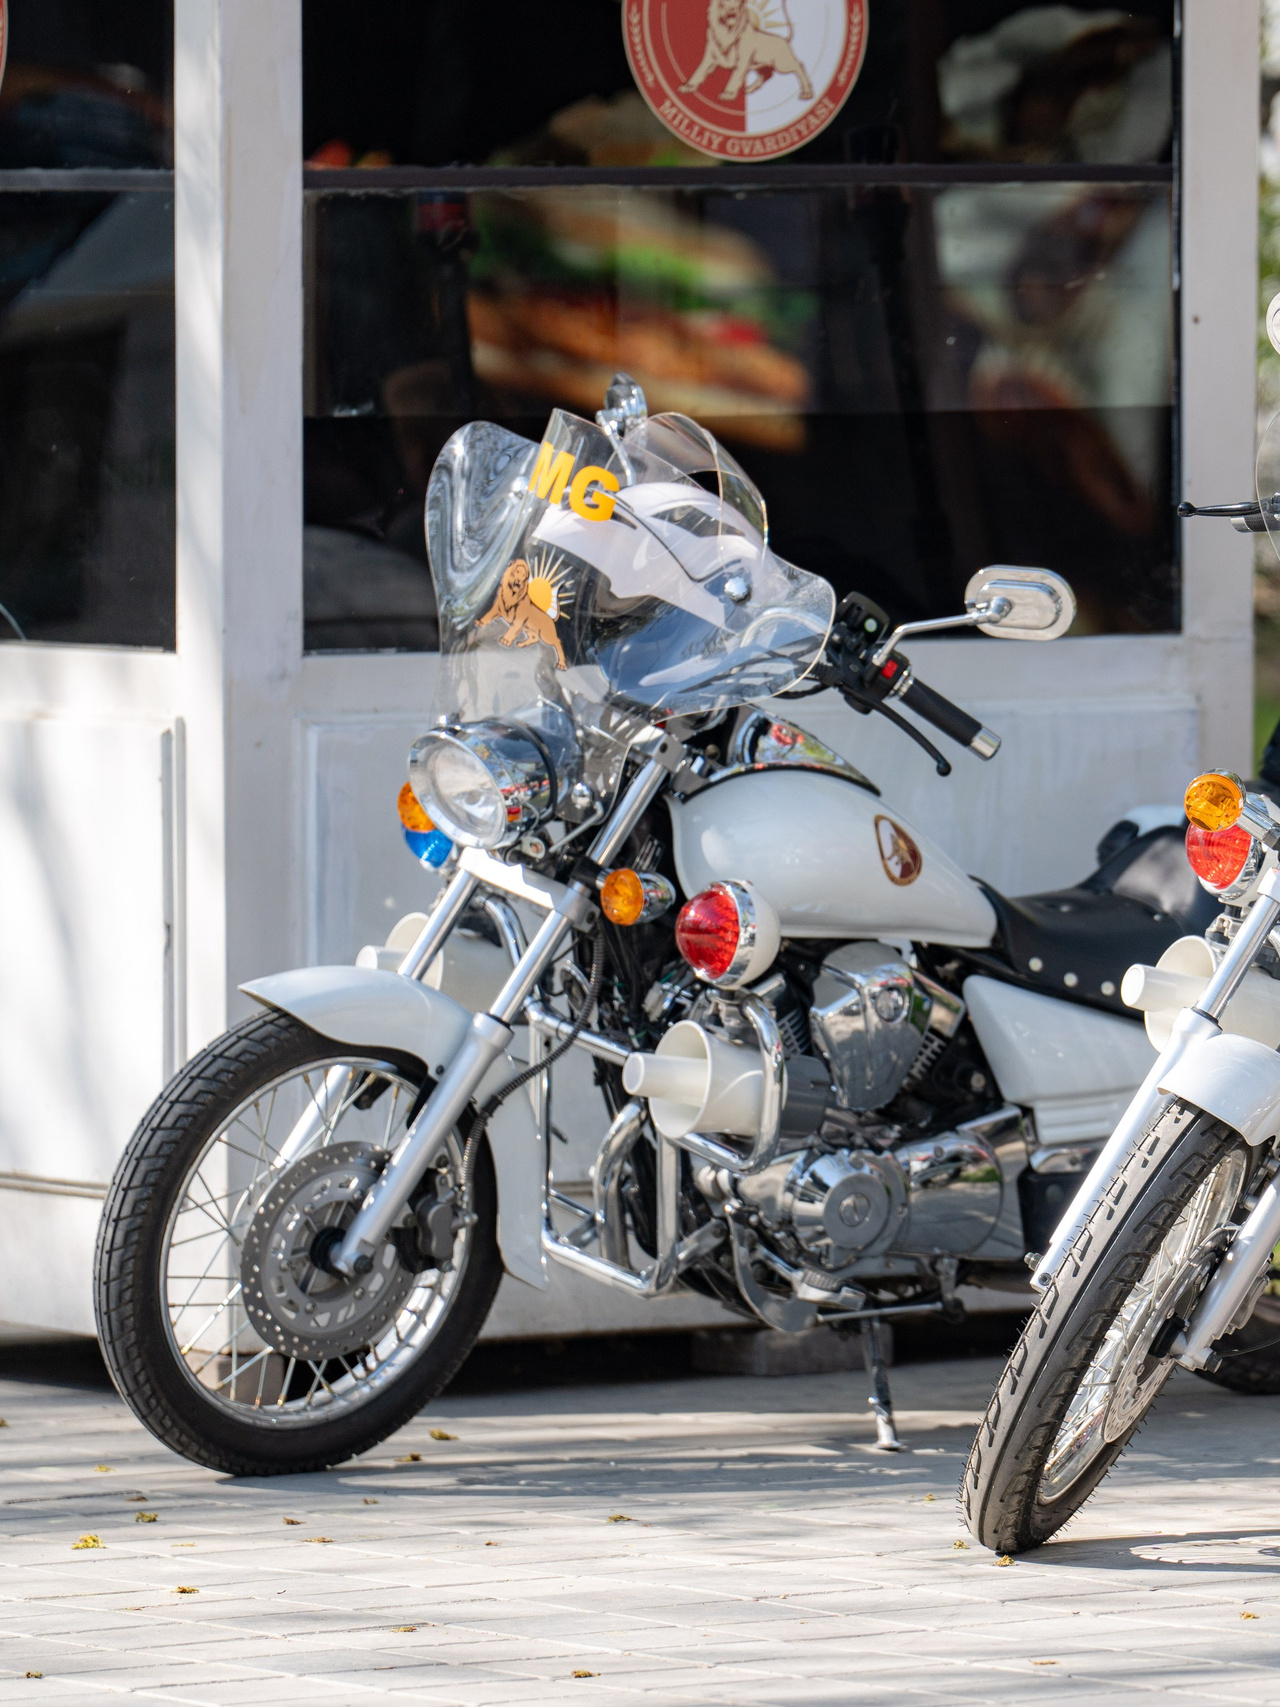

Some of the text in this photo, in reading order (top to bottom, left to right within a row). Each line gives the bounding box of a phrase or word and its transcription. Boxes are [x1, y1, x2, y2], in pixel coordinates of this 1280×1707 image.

[658, 97, 837, 155] MILLIY GVARDIYASI
[528, 440, 620, 522] MG
